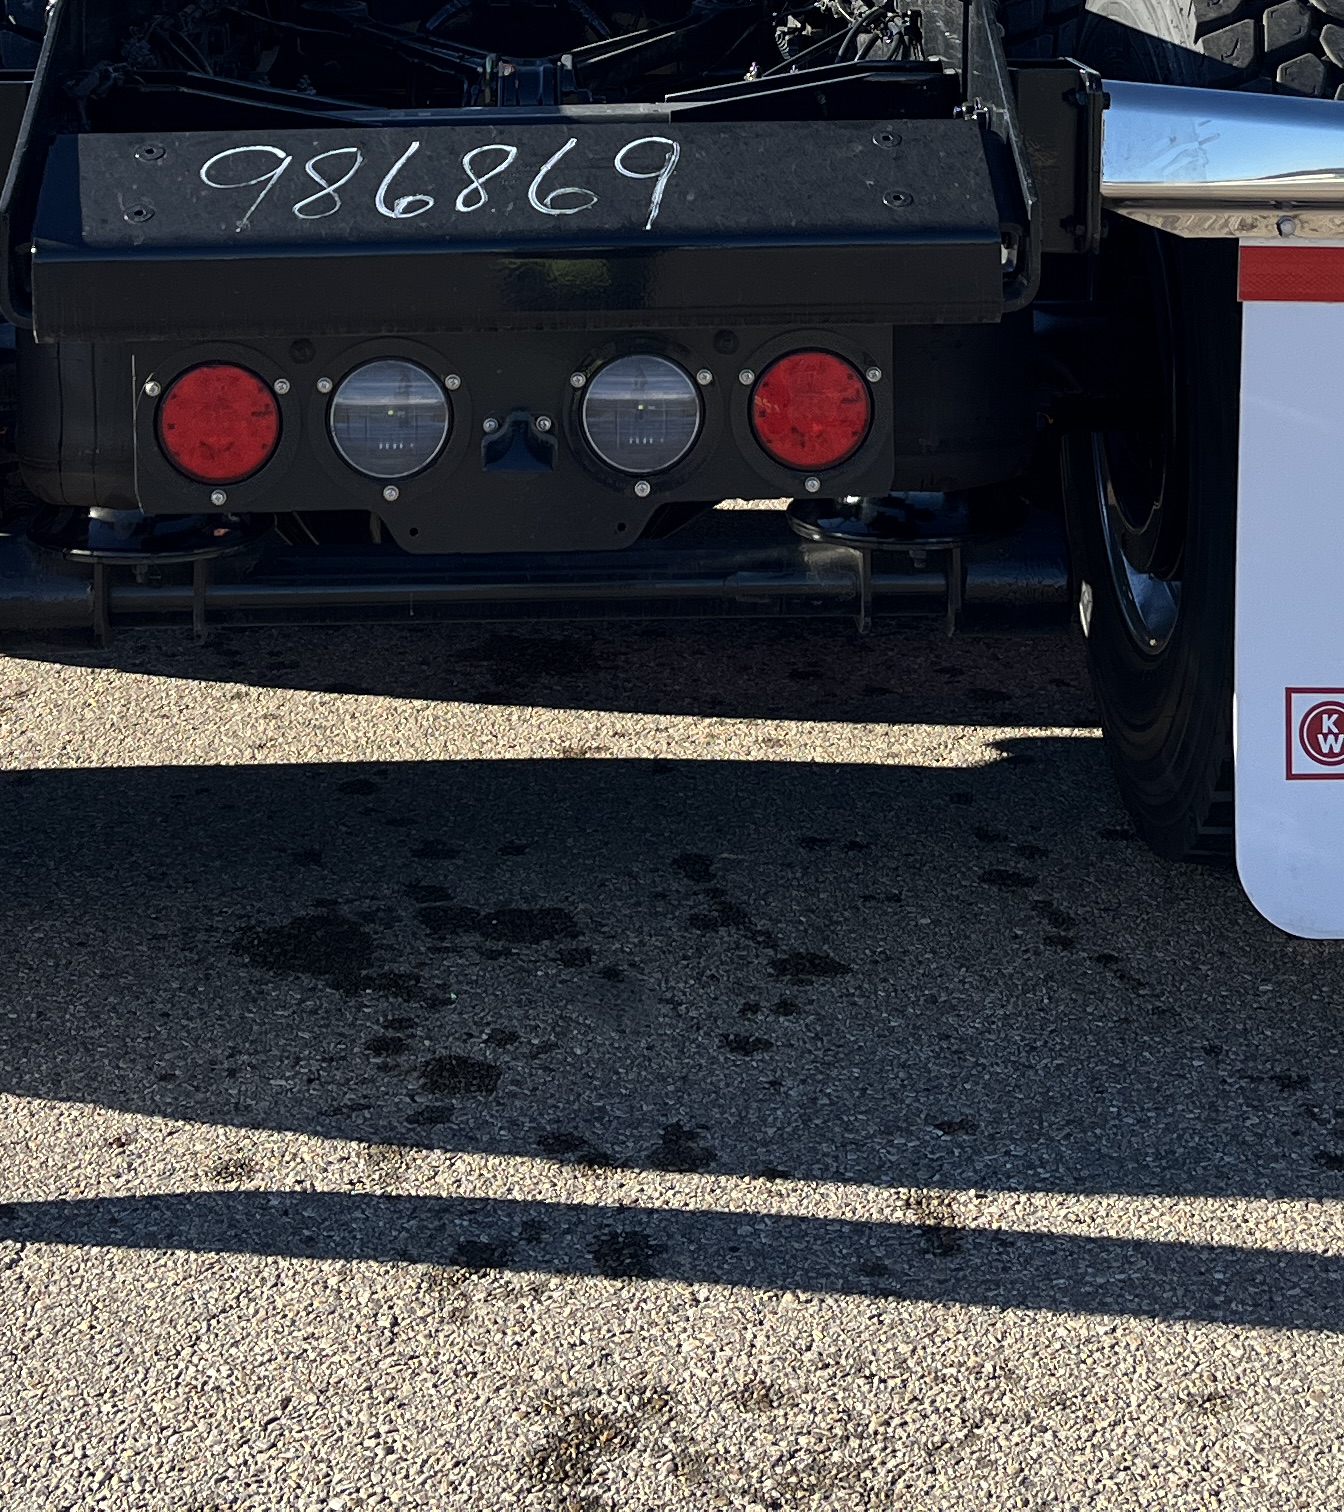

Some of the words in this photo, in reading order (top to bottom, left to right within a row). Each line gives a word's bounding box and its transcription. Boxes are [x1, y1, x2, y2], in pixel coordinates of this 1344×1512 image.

[199, 136, 680, 233] 986869
[1322, 714, 1339, 734] K
[1317, 734, 1344, 754] W
